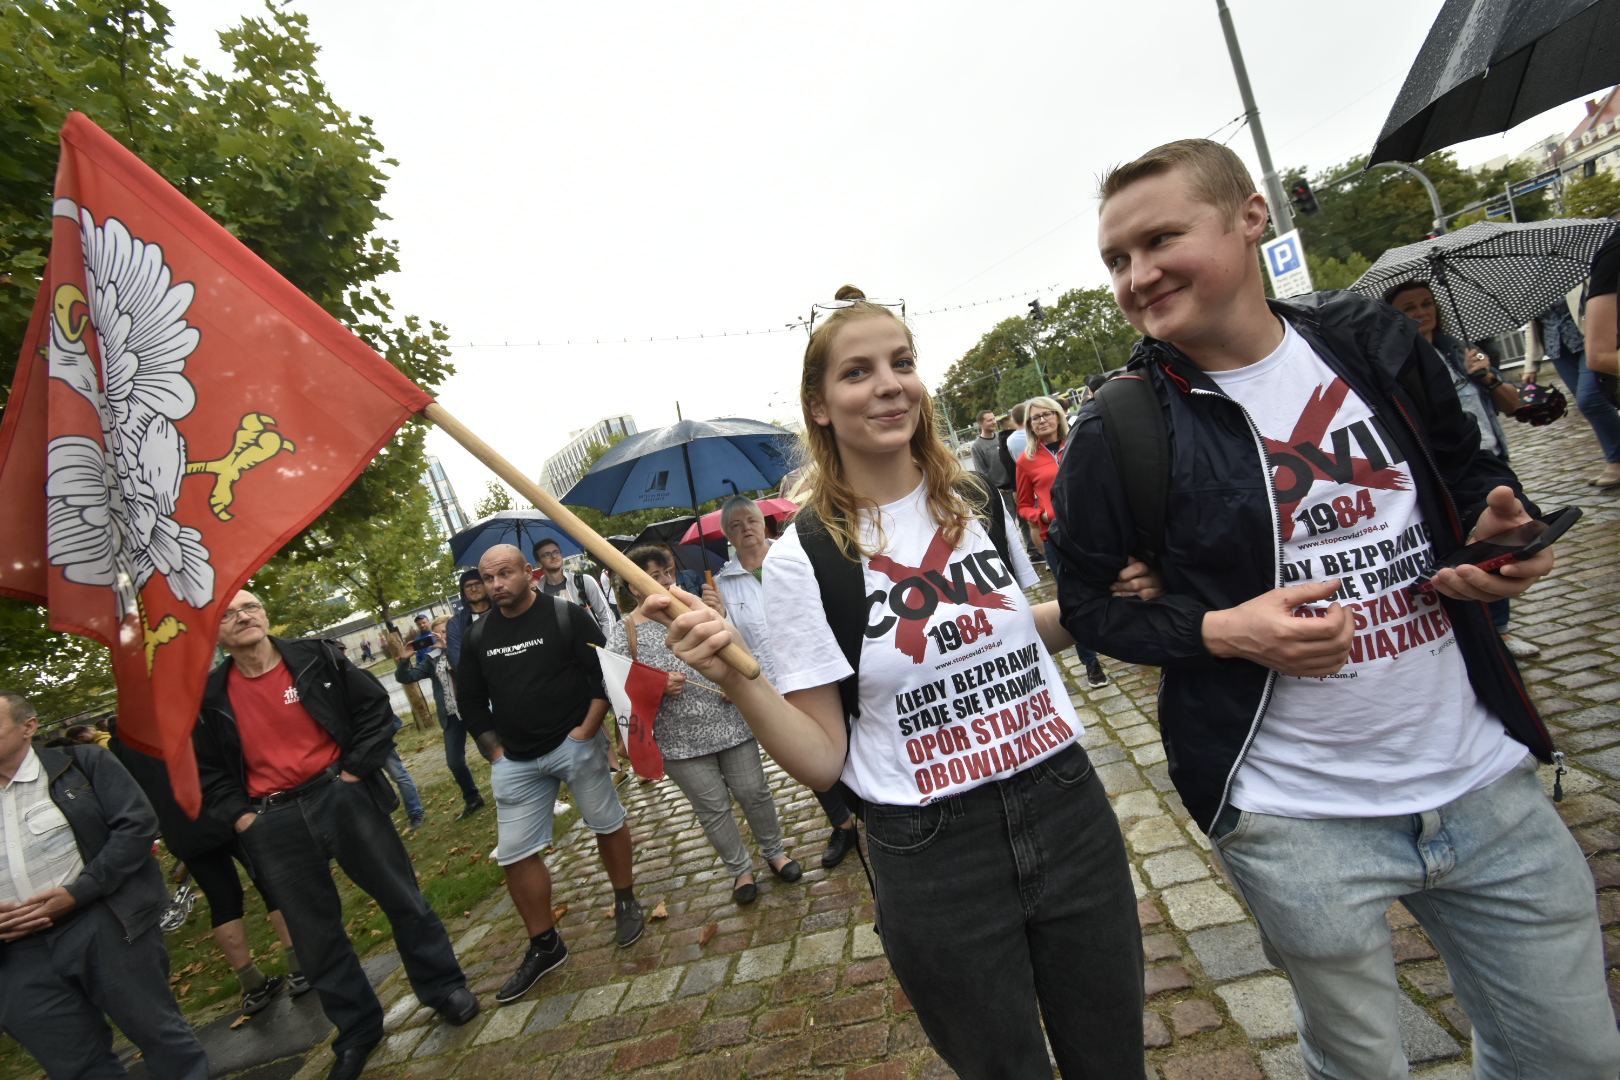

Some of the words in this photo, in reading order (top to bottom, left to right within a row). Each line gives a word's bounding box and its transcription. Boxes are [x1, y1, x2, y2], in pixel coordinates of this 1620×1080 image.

[1274, 243, 1292, 272] P
[1268, 415, 1406, 504] OVI
[1295, 488, 1377, 536] 1984
[1298, 521, 1389, 551] www.stopcovid1984.pl
[1320, 520, 1432, 576] BEZPRAWIE
[864, 549, 1013, 639] COVID
[487, 646, 514, 657] EMPORIO
[520, 638, 544, 650] ARMANI
[927, 608, 994, 655] 1984
[934, 638, 1003, 671] www.stopcovid1984.pl
[895, 678, 947, 715] KIEDY
[951, 642, 1040, 694] BEZPRAWIE
[898, 703, 952, 736] STAJE
[952, 692, 985, 720] SIĘ
[982, 666, 1046, 709] PRAWEM,
[906, 725, 972, 764] OPÓR
[971, 700, 1031, 745] STAJE
[1030, 688, 1059, 721] SIĘ
[914, 715, 1074, 795] OBOWIĄZKIEM
